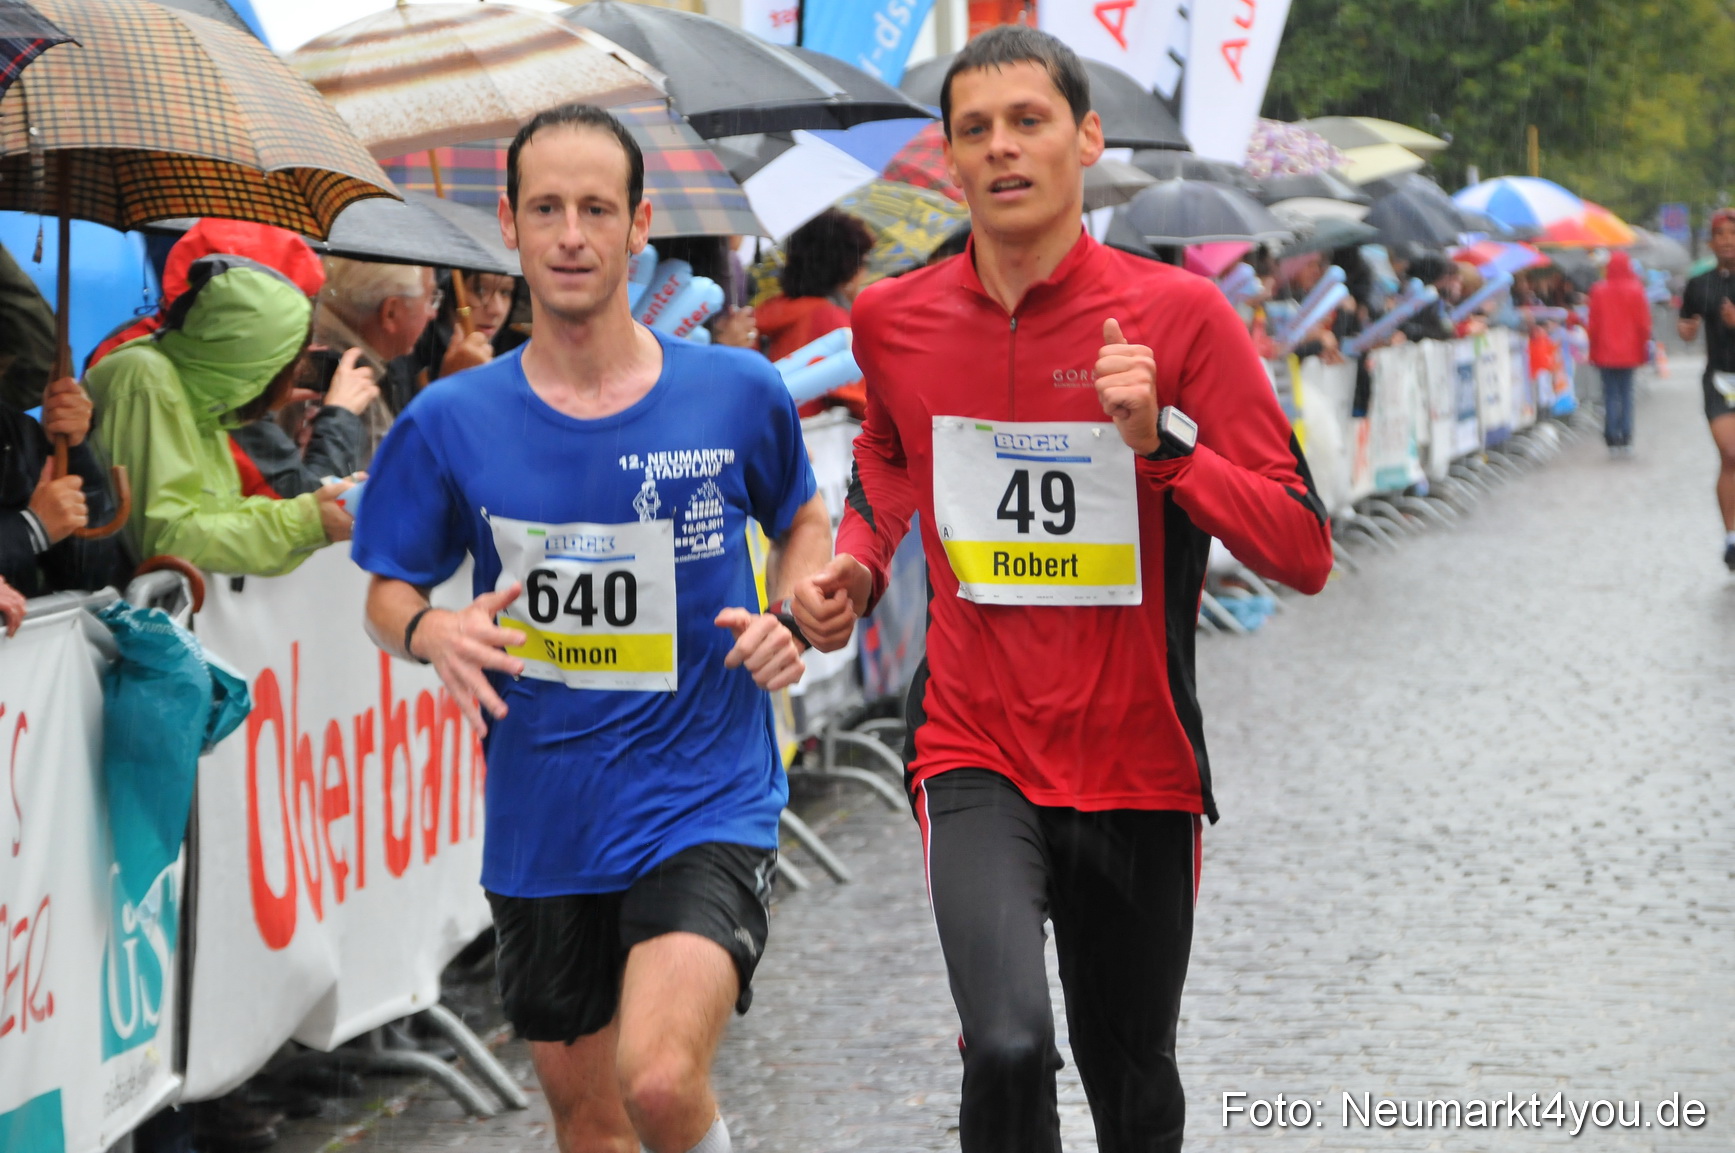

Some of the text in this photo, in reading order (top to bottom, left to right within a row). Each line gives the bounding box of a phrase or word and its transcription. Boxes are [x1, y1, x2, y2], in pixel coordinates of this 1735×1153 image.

[994, 432, 1070, 451] BOCK
[619, 449, 735, 471] 12. NEUMARKTER
[996, 468, 1076, 536] 49
[993, 550, 1079, 578] Robert
[526, 568, 638, 628] 640
[543, 638, 618, 665] Simon
